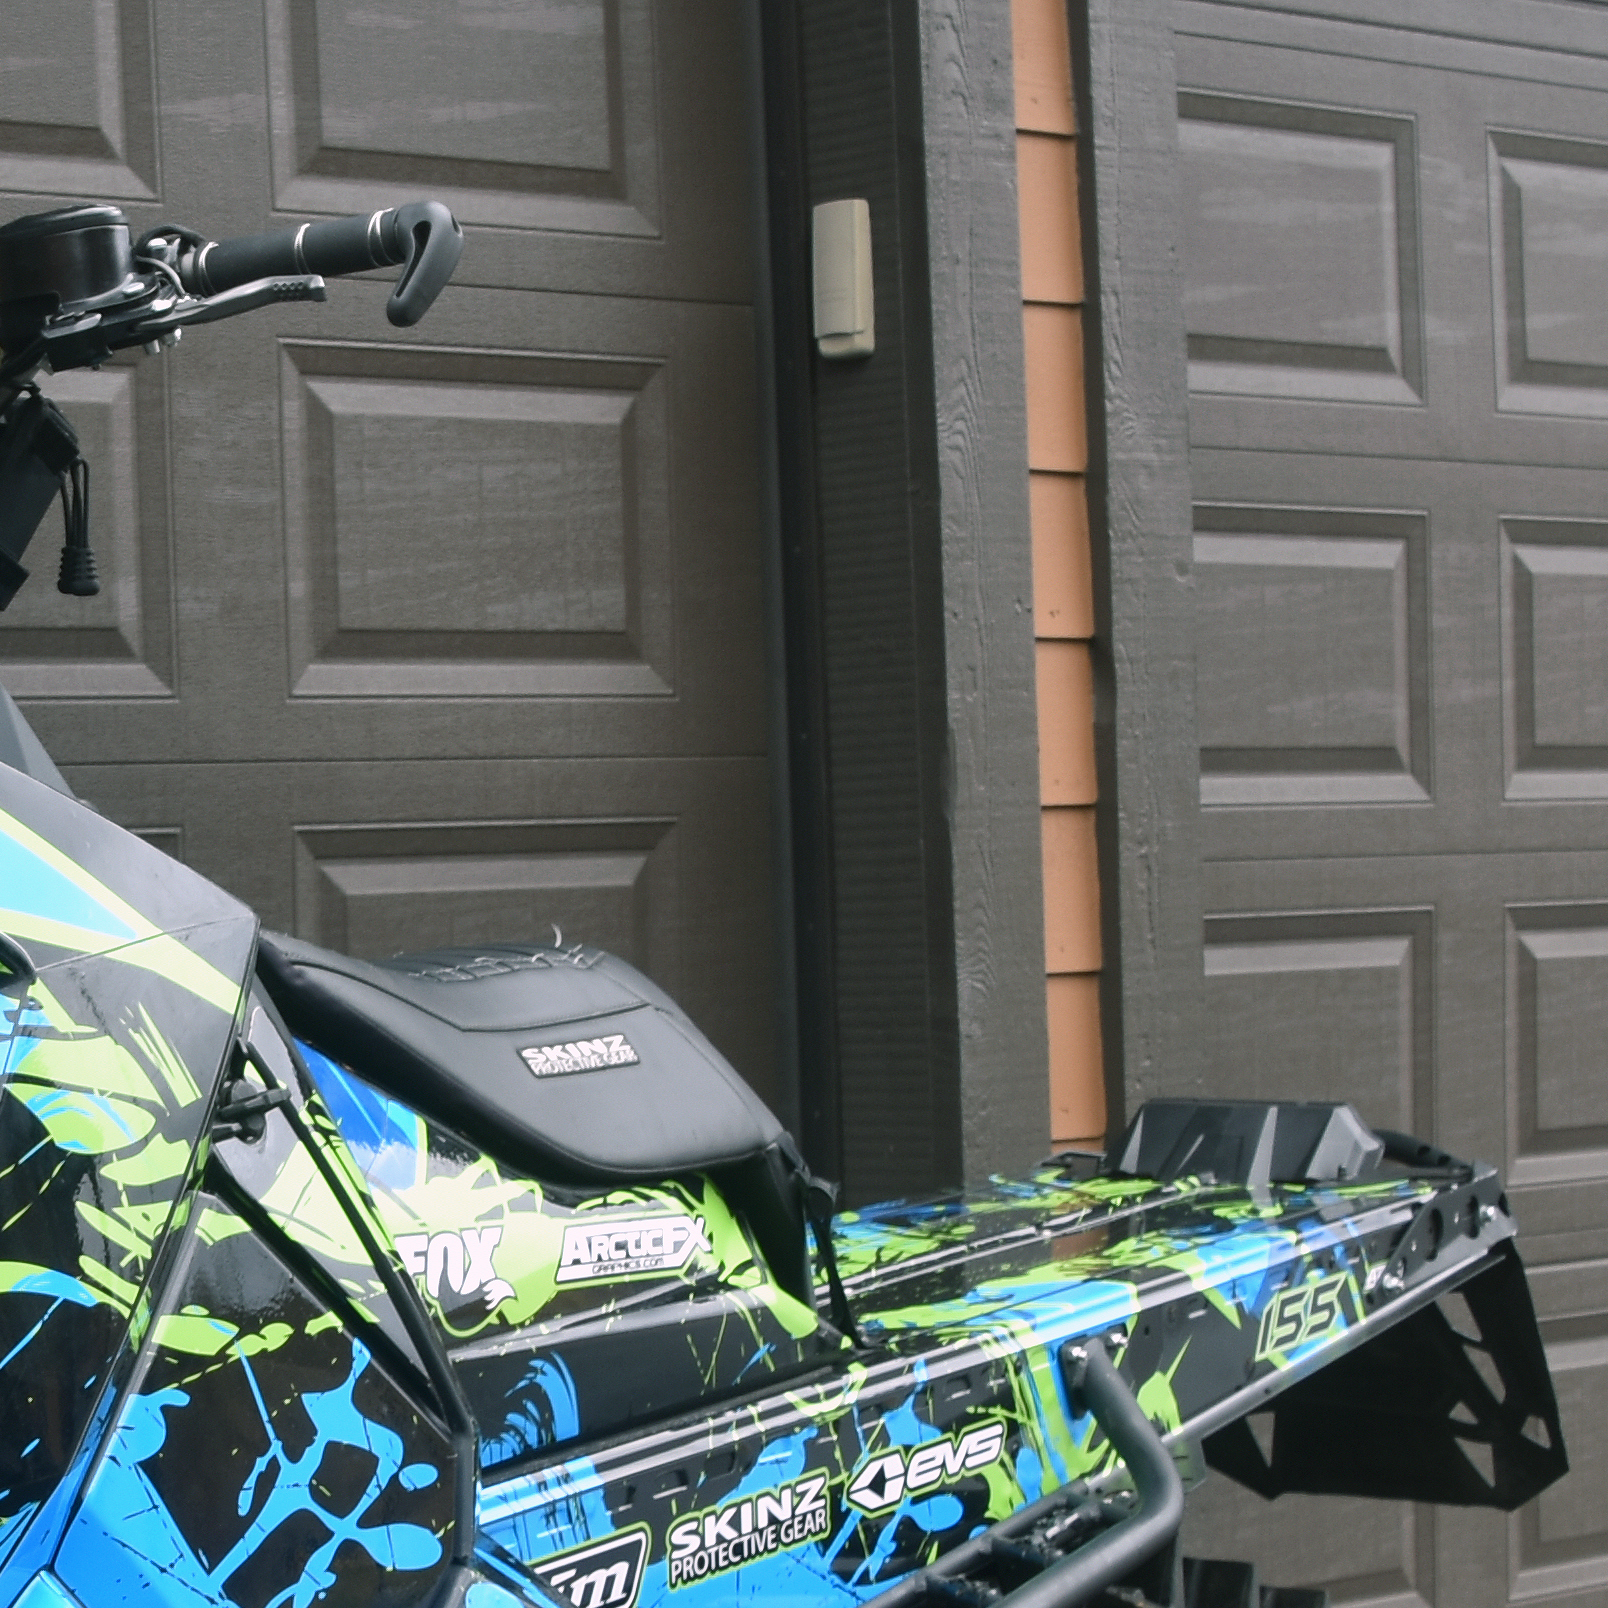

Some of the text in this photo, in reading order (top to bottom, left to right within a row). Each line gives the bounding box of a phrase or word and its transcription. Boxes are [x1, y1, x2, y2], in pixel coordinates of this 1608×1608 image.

[522, 1034, 631, 1063] SKINZ
[394, 1226, 506, 1299] FOX
[1257, 1273, 1346, 1360] 155
[671, 1476, 827, 1559] SKINZ
[671, 1508, 827, 1584] PROTECTIVE GEAR
